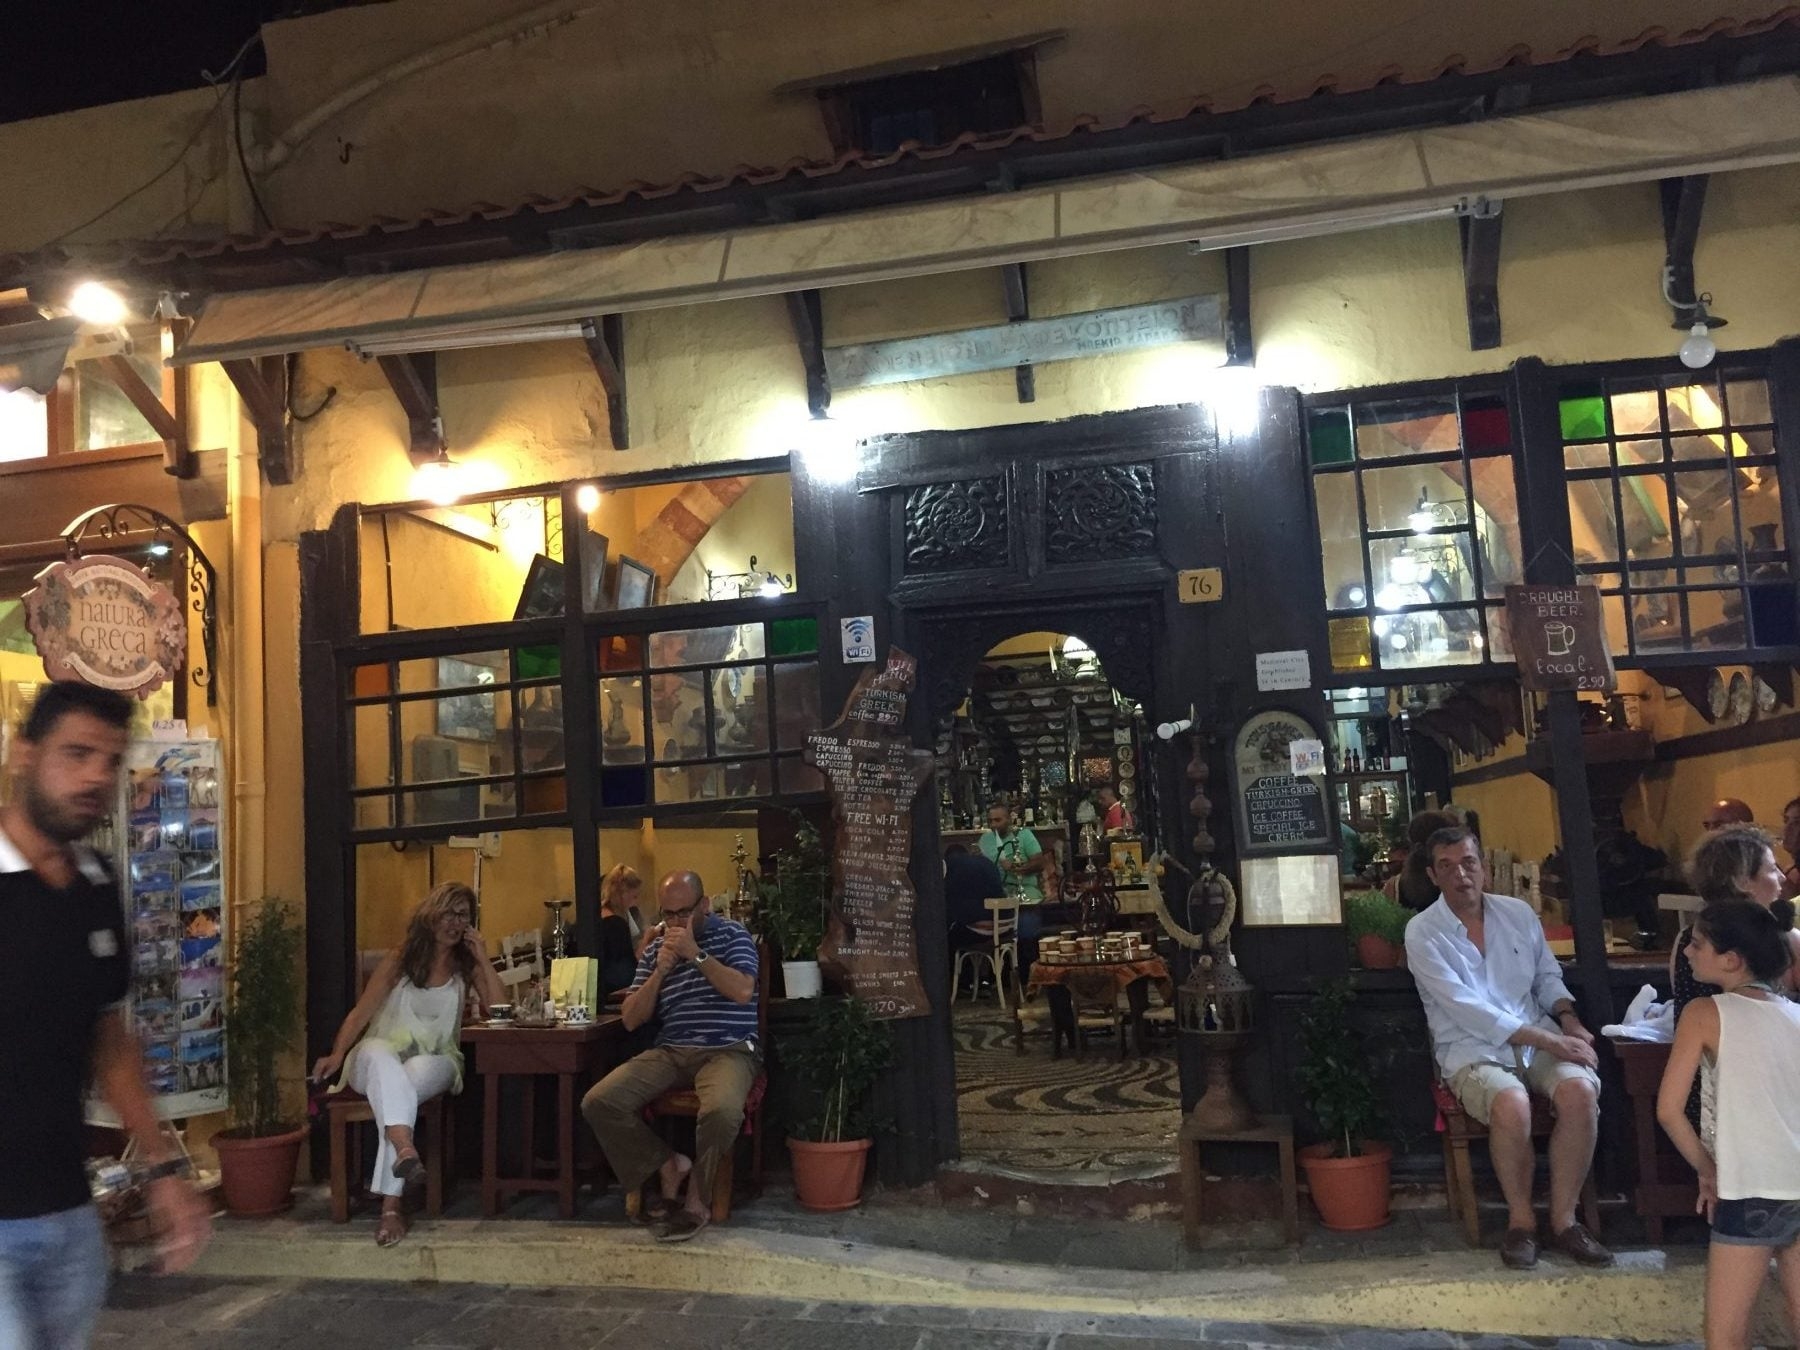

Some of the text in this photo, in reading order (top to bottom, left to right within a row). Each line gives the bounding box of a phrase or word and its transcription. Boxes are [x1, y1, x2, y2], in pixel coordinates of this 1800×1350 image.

[1189, 576, 1212, 595] 76
[1519, 591, 1581, 604] DRAUGHT
[1577, 676, 1605, 689] 2.90
[864, 689, 906, 701] TURKISH
[859, 698, 895, 711] GREEK
[808, 735, 838, 746] FREDDO
[847, 738, 881, 749] ESPRESSO
[816, 744, 851, 754] ESPRESSO
[815, 752, 853, 762] CAPUCCINO
[815, 759, 853, 770] CAPUCCINO
[858, 762, 887, 772] FREDDO
[828, 767, 852, 777] FRAPPE
[859, 778, 883, 787] COFFEE
[1258, 776, 1299, 789] COFFEE
[847, 811, 898, 827] FREE WI-FI
[1251, 812, 1267, 824] ICE
[1253, 820, 1316, 834] SPECIAL ICE
[1268, 832, 1305, 843] CREAM
